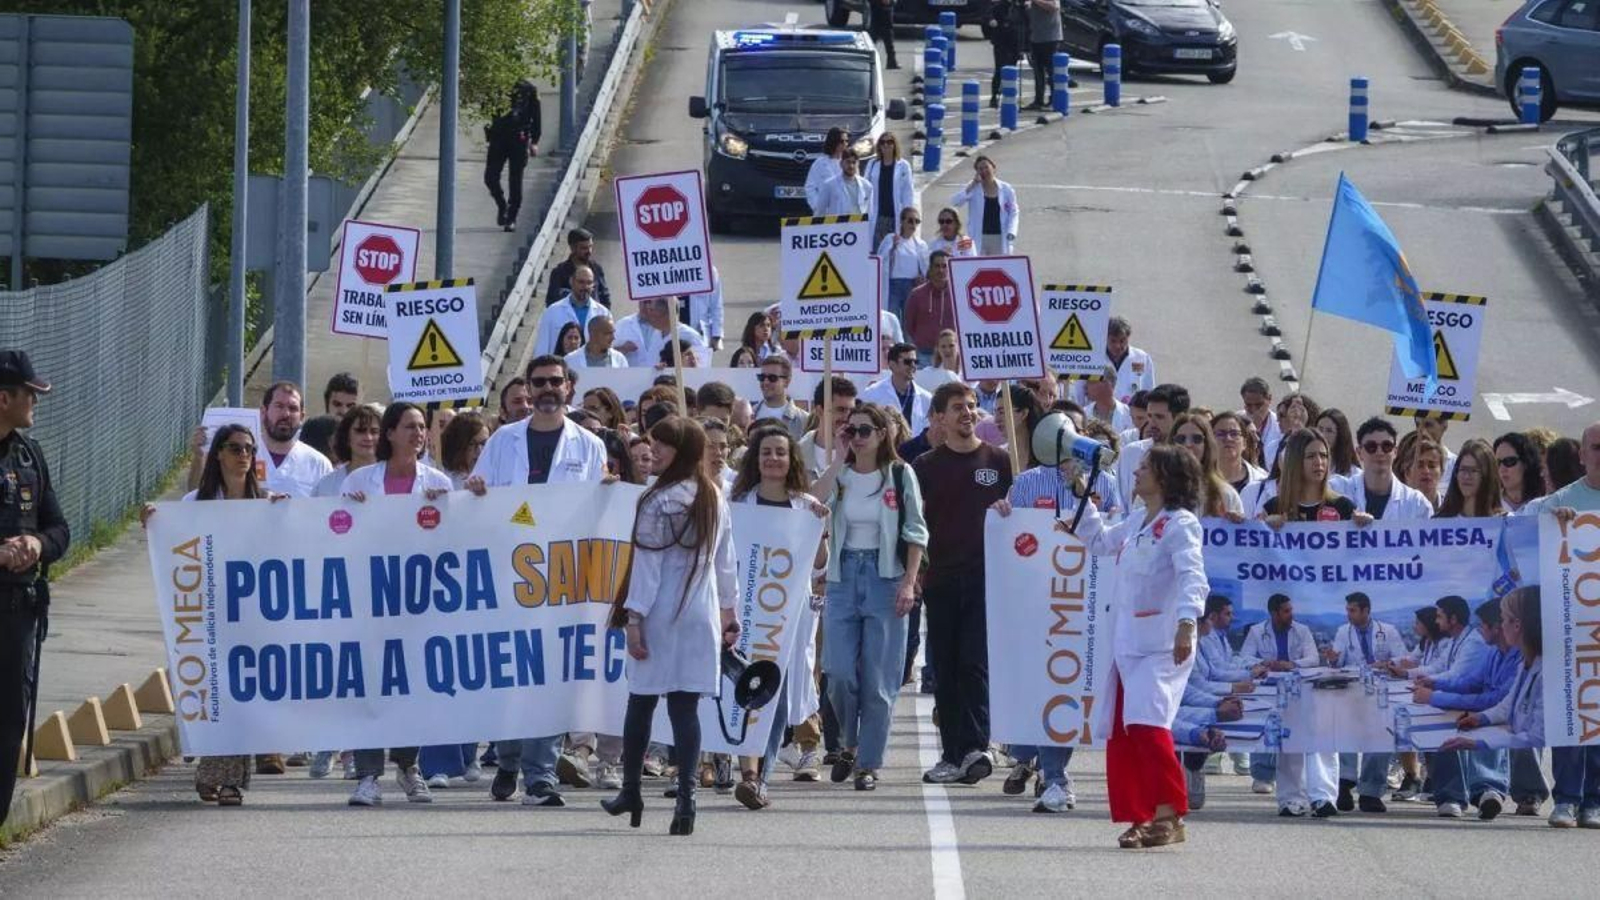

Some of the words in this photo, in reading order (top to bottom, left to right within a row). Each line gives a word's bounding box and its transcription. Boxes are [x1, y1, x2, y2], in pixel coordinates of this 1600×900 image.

[639, 201, 684, 224] STOP
[792, 232, 857, 249] RIESGO
[358, 249, 399, 271] STOP
[632, 245, 702, 267] TRABALLO
[637, 272, 660, 287] SEN
[663, 266, 703, 284] LÍMITE
[343, 289, 386, 308] TRABA
[971, 286, 1015, 306] STOP
[1048, 298, 1101, 311] RIESGO
[396, 297, 465, 317] RIESGO
[800, 303, 850, 315] MEDICO
[342, 310, 362, 324] SEN
[834, 314, 868, 323] TRABAJO
[1427, 310, 1473, 328] ESGO
[965, 331, 1033, 348] TRABALLO
[810, 347, 824, 360] SE
[835, 344, 871, 361] LÍMITE
[971, 355, 992, 368] SEN
[997, 351, 1034, 368] LÍMITE
[1050, 354, 1091, 362] MEDICO
[411, 373, 464, 387] MEDICO
[447, 385, 483, 394] TRABAJO
[1406, 383, 1457, 397] MECO
[1439, 399, 1471, 408] TRABAJO
[1235, 528, 1340, 550] ESTAMOS
[1346, 530, 1378, 549] EN
[1384, 528, 1414, 548] LA
[1419, 527, 1493, 549] MESA,
[205, 534, 216, 610] Independentes
[747, 544, 760, 604] Facultativos
[1237, 562, 1316, 582] SOMOS
[1322, 565, 1347, 582] EL
[1353, 554, 1423, 582] MENÚ
[225, 557, 352, 622] POLA
[370, 548, 498, 617] NOSA
[512, 537, 632, 608] SANI
[1562, 568, 1570, 623] Facultativos
[744, 605, 751, 619] de
[1088, 591, 1096, 622] Galicia
[207, 610, 216, 645] Galicia
[1087, 623, 1095, 635] de
[1564, 624, 1572, 635] de
[208, 647, 216, 660] de
[1564, 637, 1572, 667] Galicia
[228, 641, 365, 702] COIDA
[381, 639, 410, 696] A
[425, 628, 546, 697] QUEN
[559, 623, 596, 682] TE
[604, 627, 628, 683] C
[1084, 637, 1094, 691] Facultativos
[207, 662, 219, 723] Facultativos
[1564, 668, 1574, 737] Independentes
